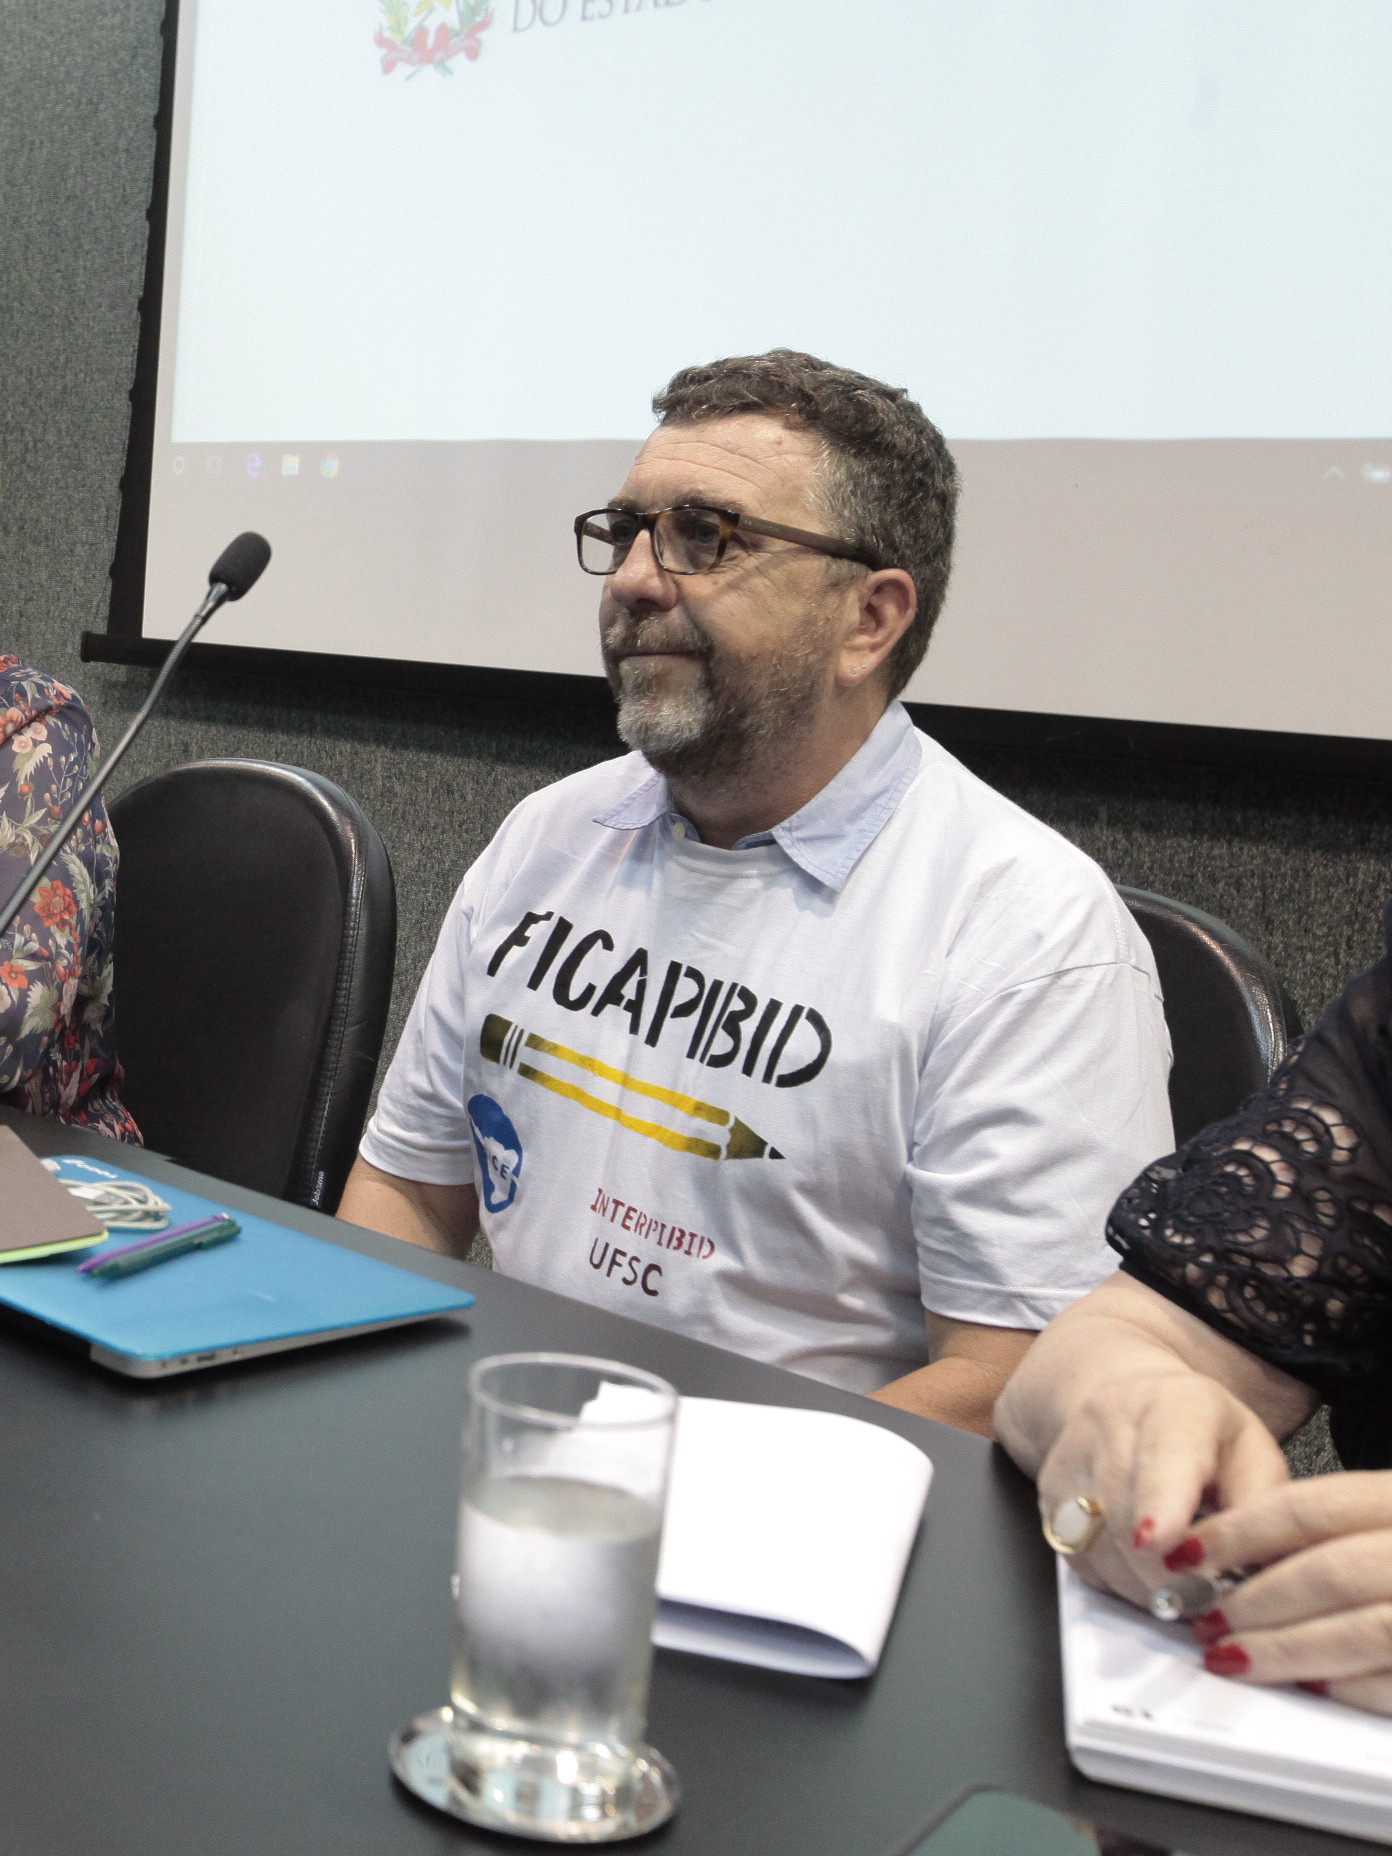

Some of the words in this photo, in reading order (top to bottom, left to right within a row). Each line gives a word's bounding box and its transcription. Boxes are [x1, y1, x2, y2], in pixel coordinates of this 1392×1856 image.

[487, 911, 832, 1088] FICAPIBID
[591, 1187, 715, 1260] INTERPIBID
[589, 1237, 662, 1296] UFSC
